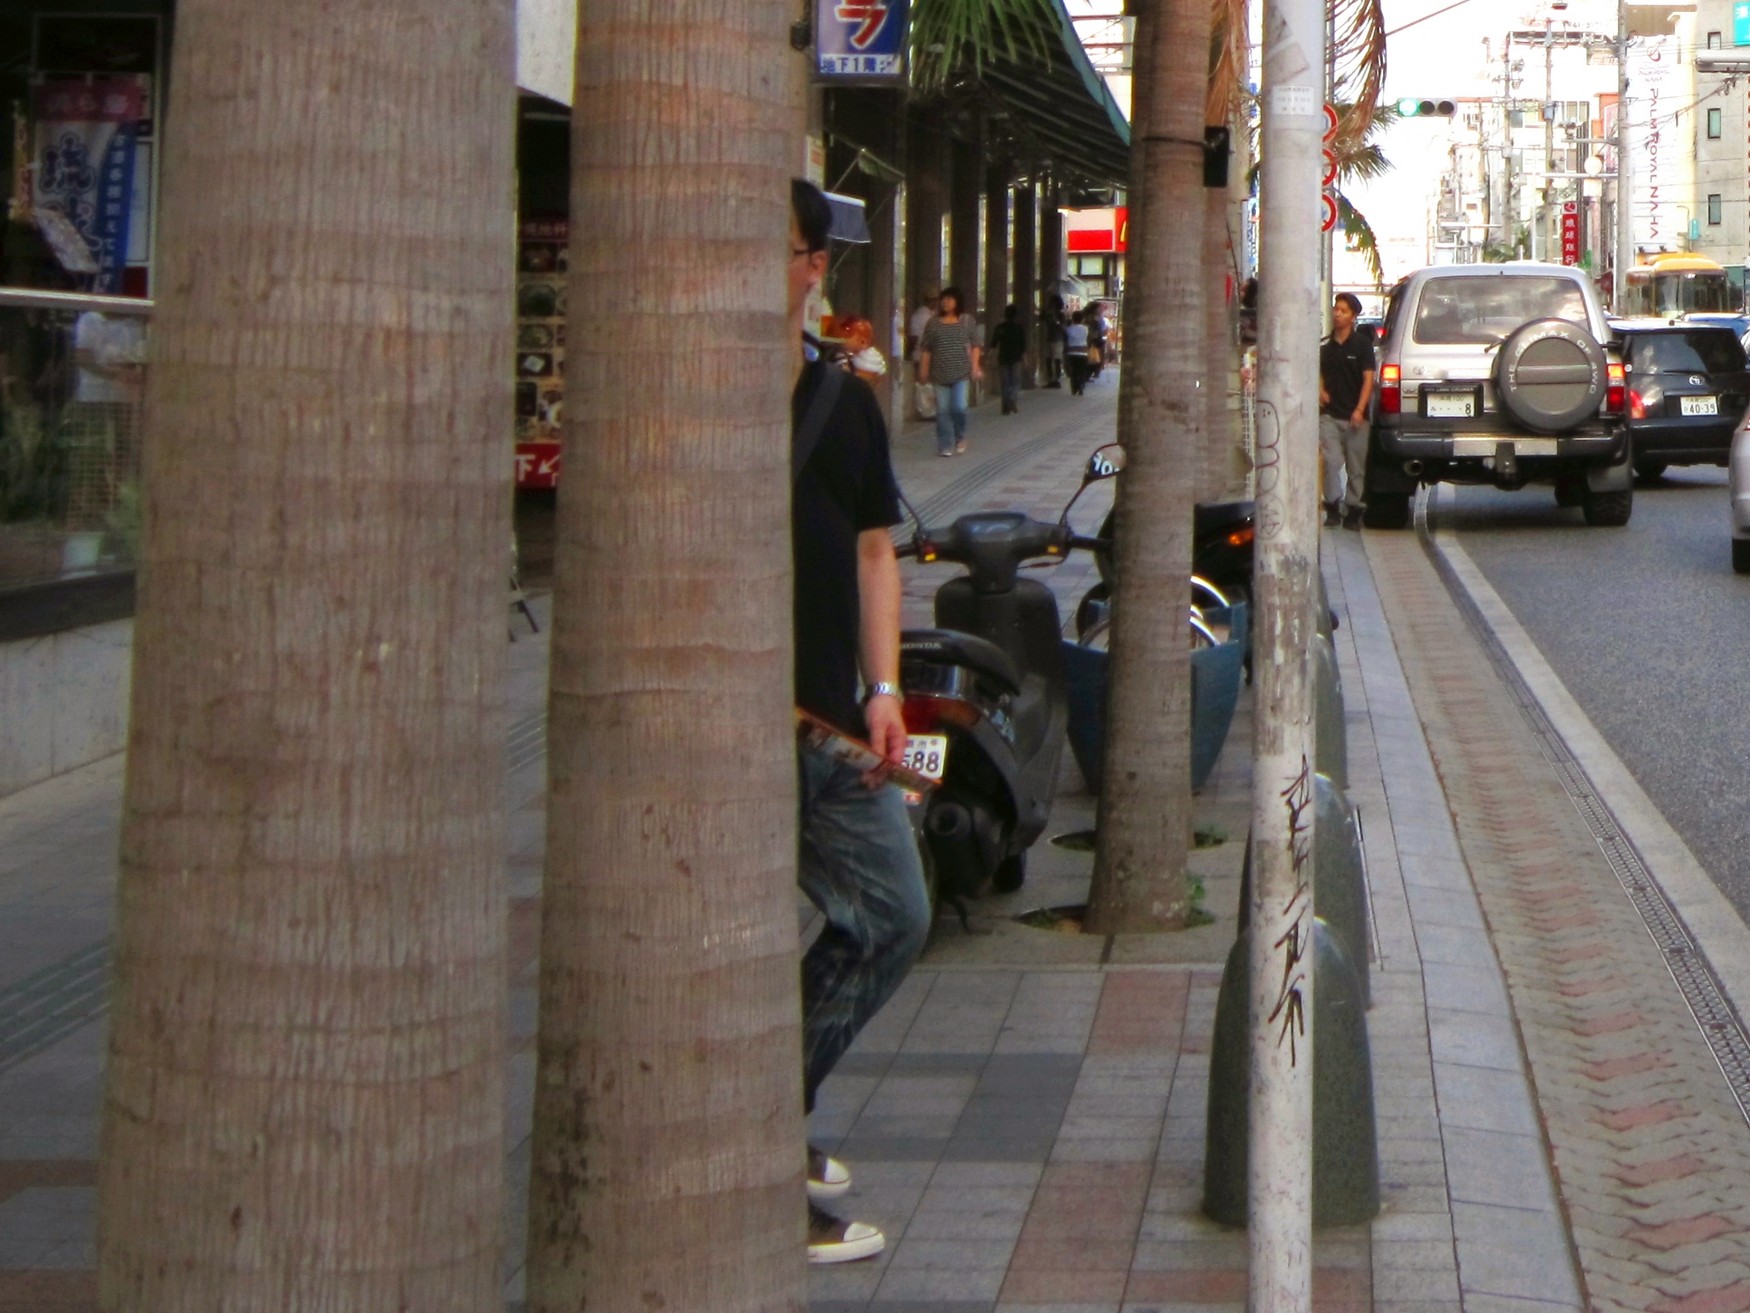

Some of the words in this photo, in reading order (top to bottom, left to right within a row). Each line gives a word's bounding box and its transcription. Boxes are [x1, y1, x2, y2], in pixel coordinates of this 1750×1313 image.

[1650, 88, 1659, 129] PALM
[1650, 131, 1659, 183] ROYAL
[1650, 185, 1659, 239] NAHA
[1690, 404, 1716, 414] 40-39
